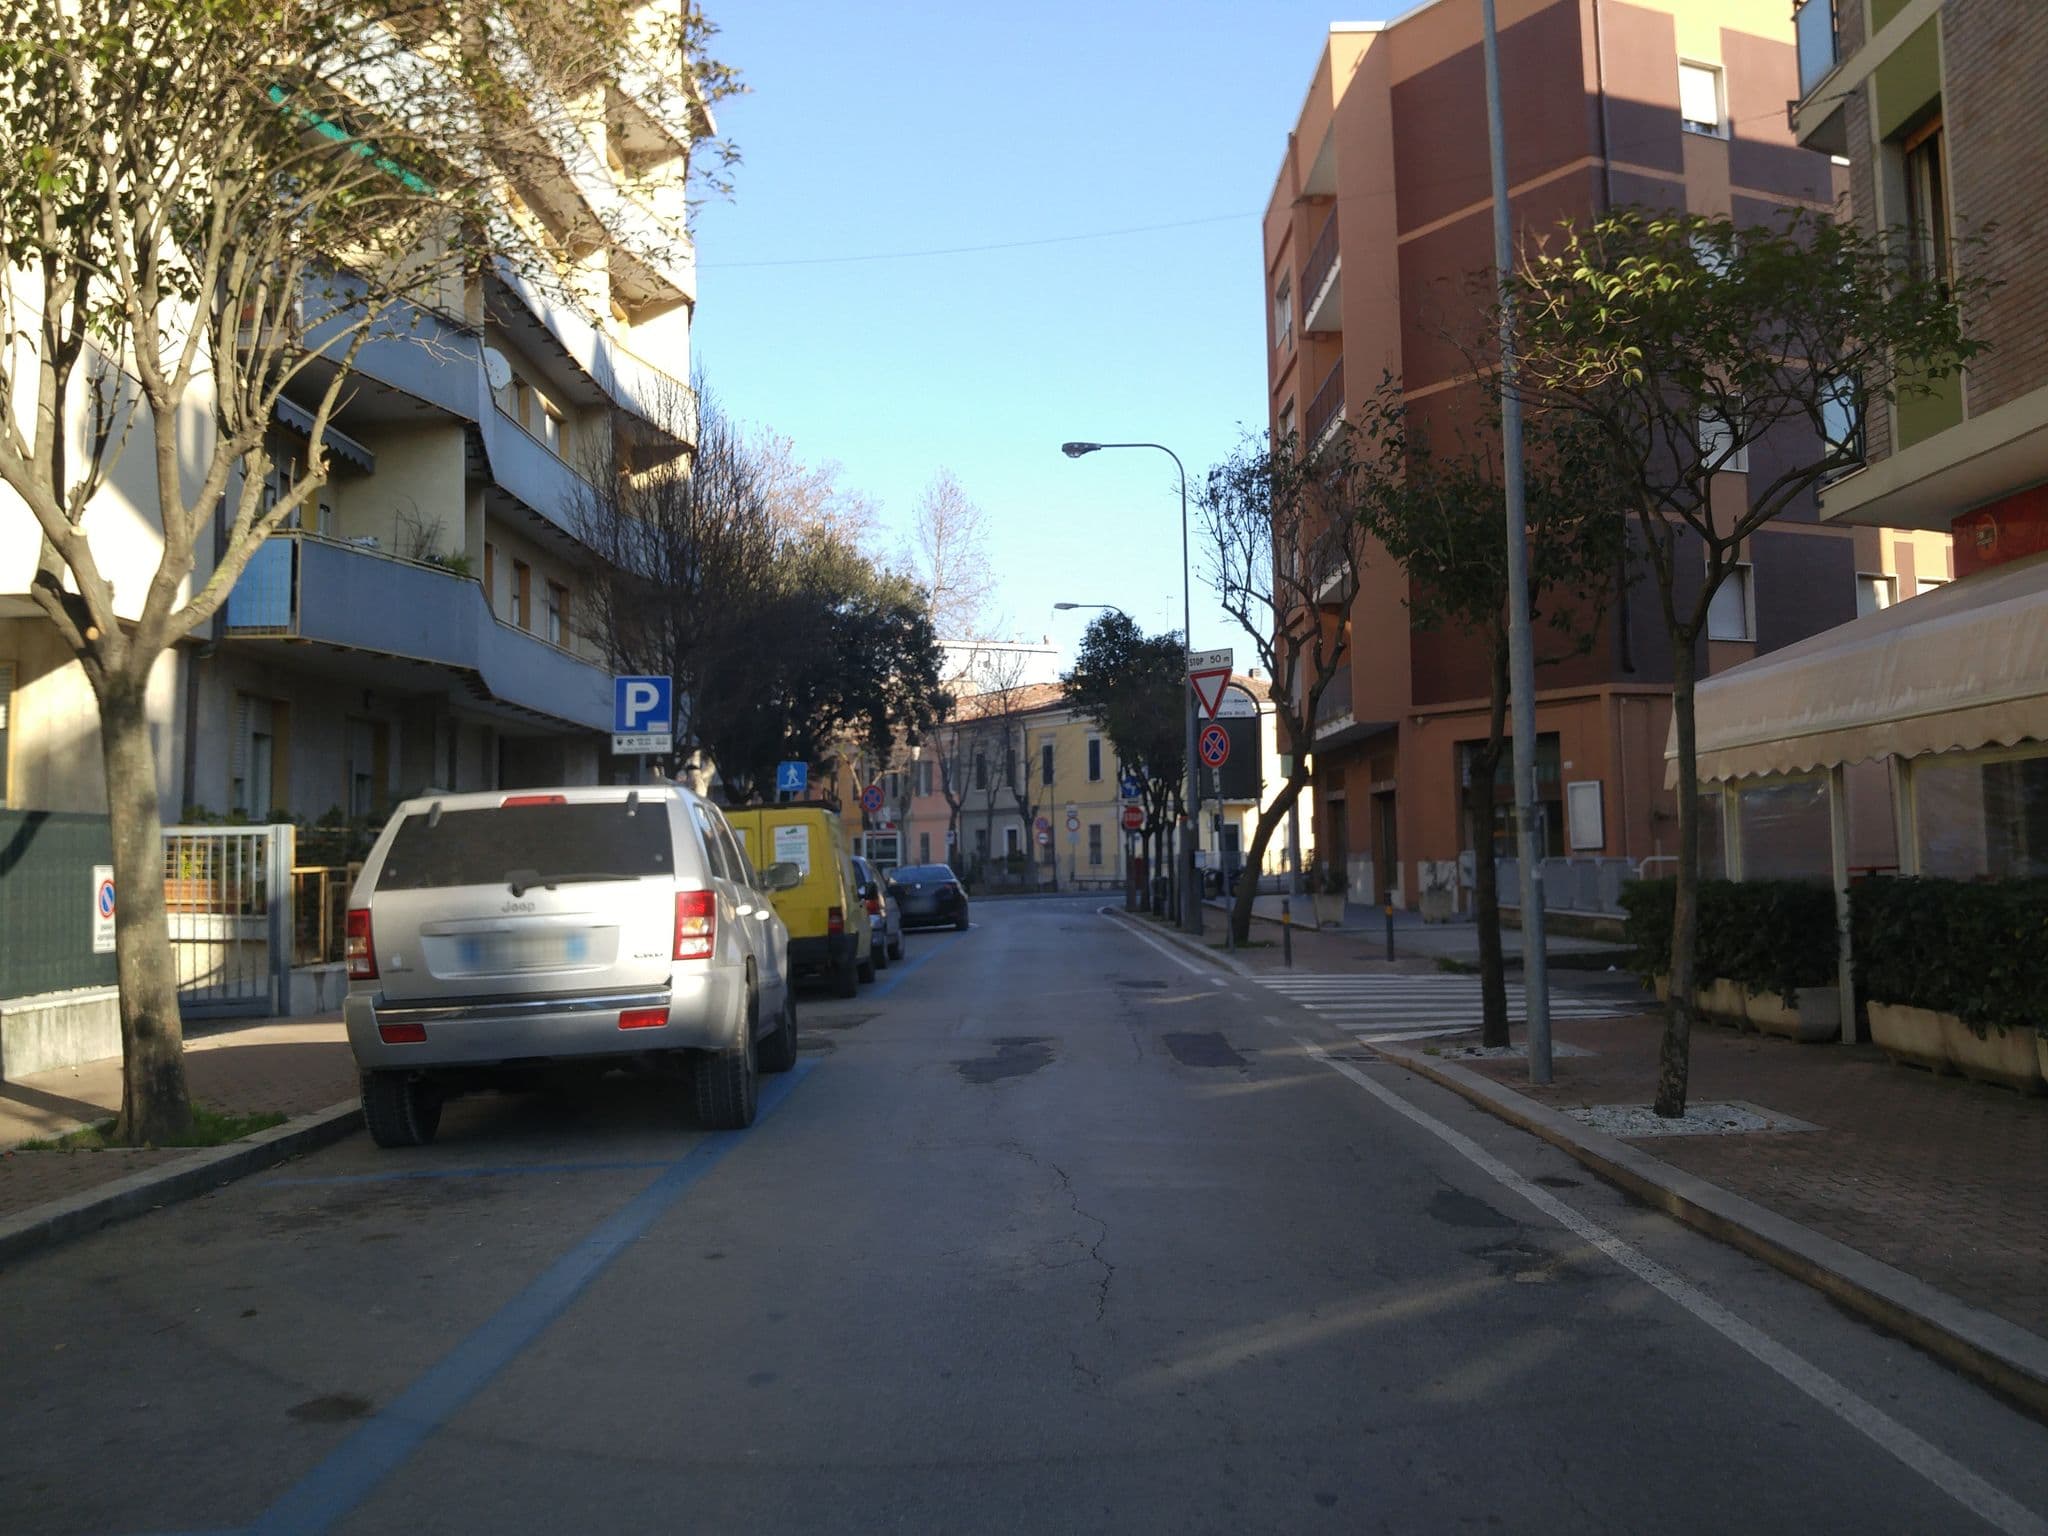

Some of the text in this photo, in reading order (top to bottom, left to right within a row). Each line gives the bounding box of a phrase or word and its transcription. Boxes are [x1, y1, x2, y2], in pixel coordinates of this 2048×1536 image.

[1189, 657, 1204, 666] STOP
[1210, 655, 1221, 663] 50
[625, 682, 660, 727] P
[501, 901, 536, 912] Jeep
